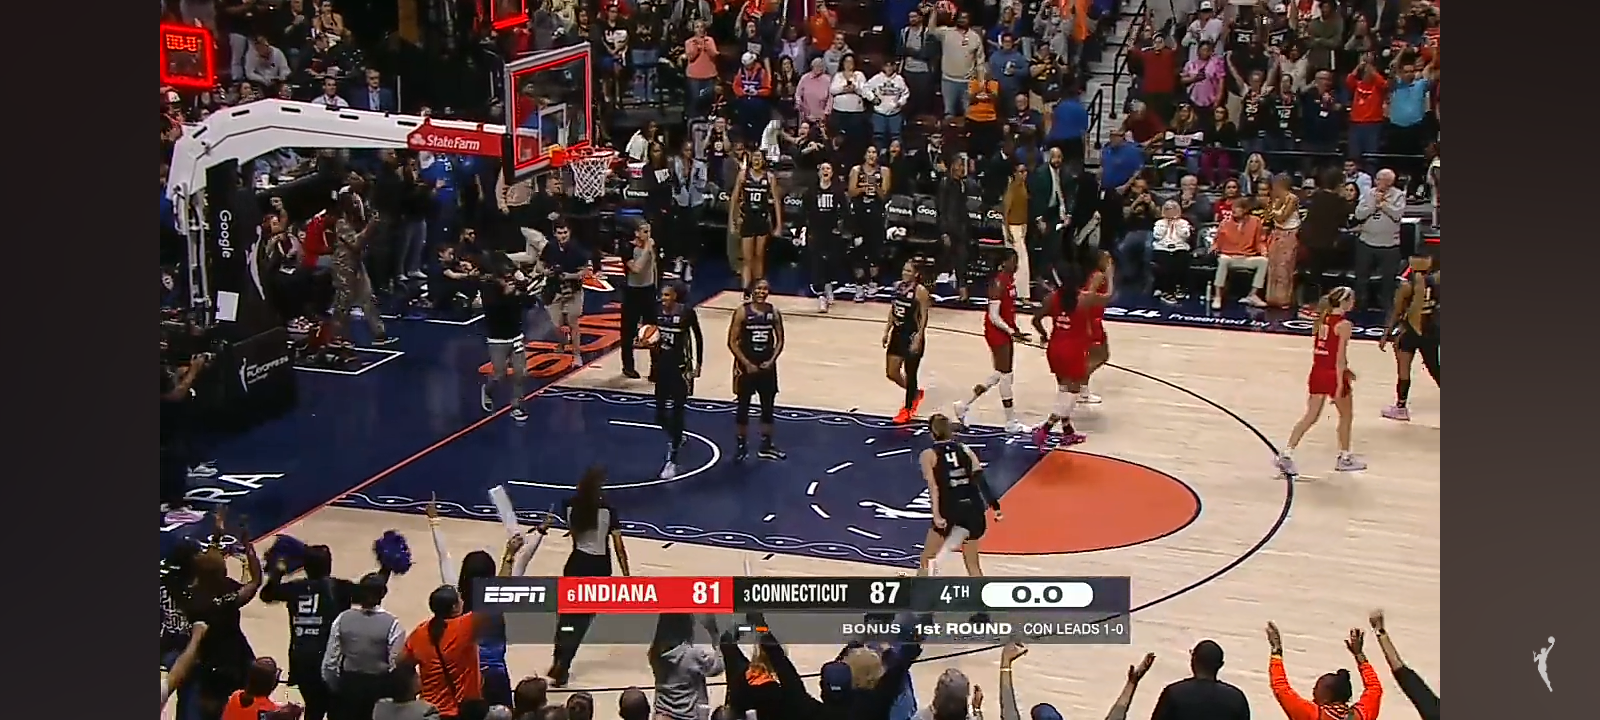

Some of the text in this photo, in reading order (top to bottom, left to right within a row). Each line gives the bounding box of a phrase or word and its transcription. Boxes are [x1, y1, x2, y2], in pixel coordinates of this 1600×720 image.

[750, 192, 762, 202] 10
[218, 209, 235, 259] Google
[752, 331, 769, 343] 25
[944, 450, 960, 468] 4
[298, 593, 320, 613] 21
